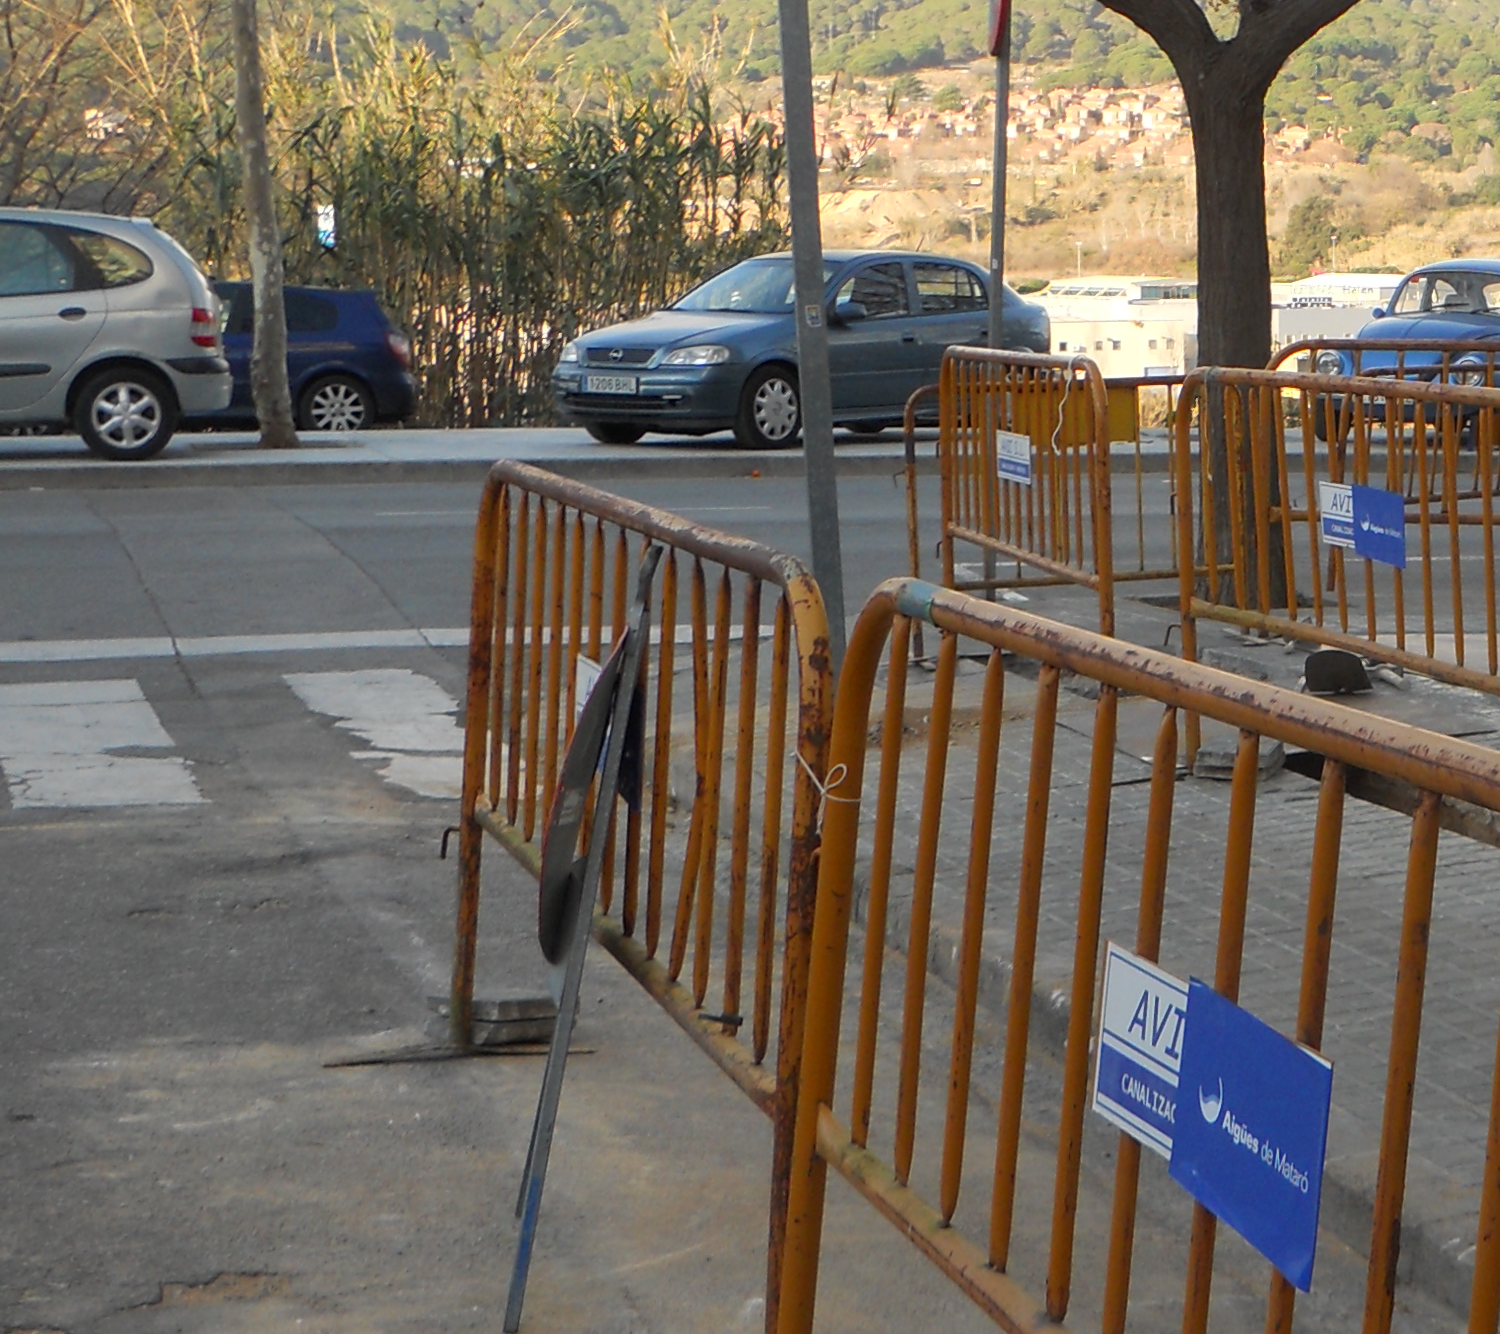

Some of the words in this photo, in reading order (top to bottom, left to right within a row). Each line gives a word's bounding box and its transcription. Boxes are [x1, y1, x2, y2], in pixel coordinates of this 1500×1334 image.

[1222, 1110, 1259, 1154] Aigües
[1260, 1139, 1273, 1166] de
[1274, 1146, 1309, 1193] Mataró
